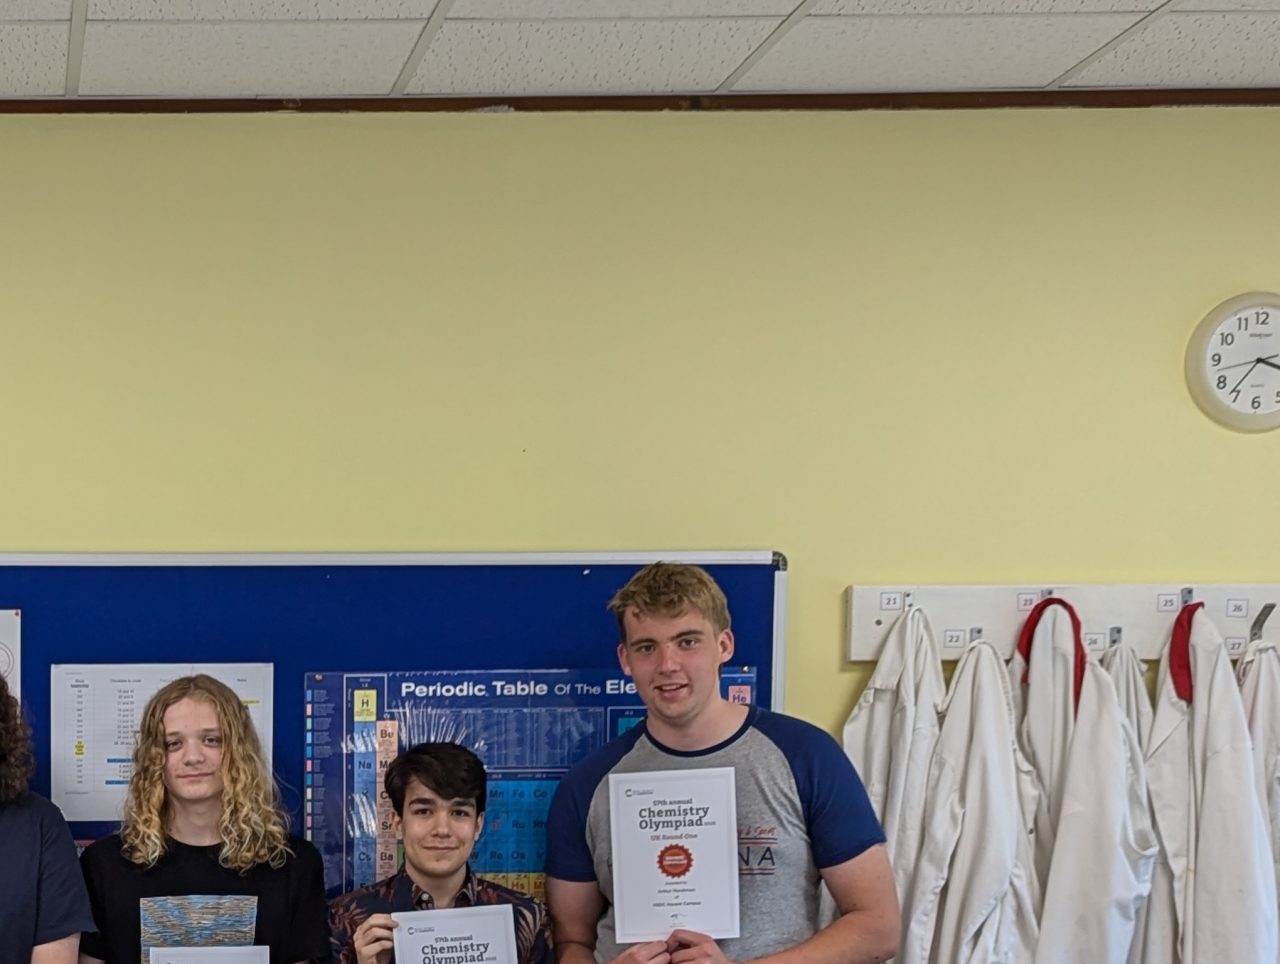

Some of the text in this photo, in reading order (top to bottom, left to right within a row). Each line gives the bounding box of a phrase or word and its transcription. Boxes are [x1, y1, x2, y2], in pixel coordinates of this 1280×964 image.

[1237, 317, 1249, 331] 11
[1255, 311, 1270, 325] 12
[1220, 332, 1235, 346] 10
[1211, 353, 1222, 367] 9
[1216, 375, 1227, 390] 8
[1231, 389, 1242, 403] 7
[1251, 396, 1261, 410] 6
[885, 597, 897, 606] 21
[1163, 598, 1175, 607] 25
[1232, 604, 1243, 613] 26
[948, 634, 960, 643] 22
[1230, 642, 1241, 651] 27
[401, 682, 486, 697] Periodic
[491, 680, 548, 696] Table
[554, 681, 572, 695] Of
[574, 683, 601, 695] The
[361, 698, 370, 708] H
[380, 728, 394, 739] Be
[358, 760, 372, 769] Na
[533, 789, 548, 798] Co
[638, 805, 710, 819] Chemistry
[639, 816, 704, 831] Olympiad
[380, 852, 394, 861] Ba
[421, 942, 490, 956] Chemistry
